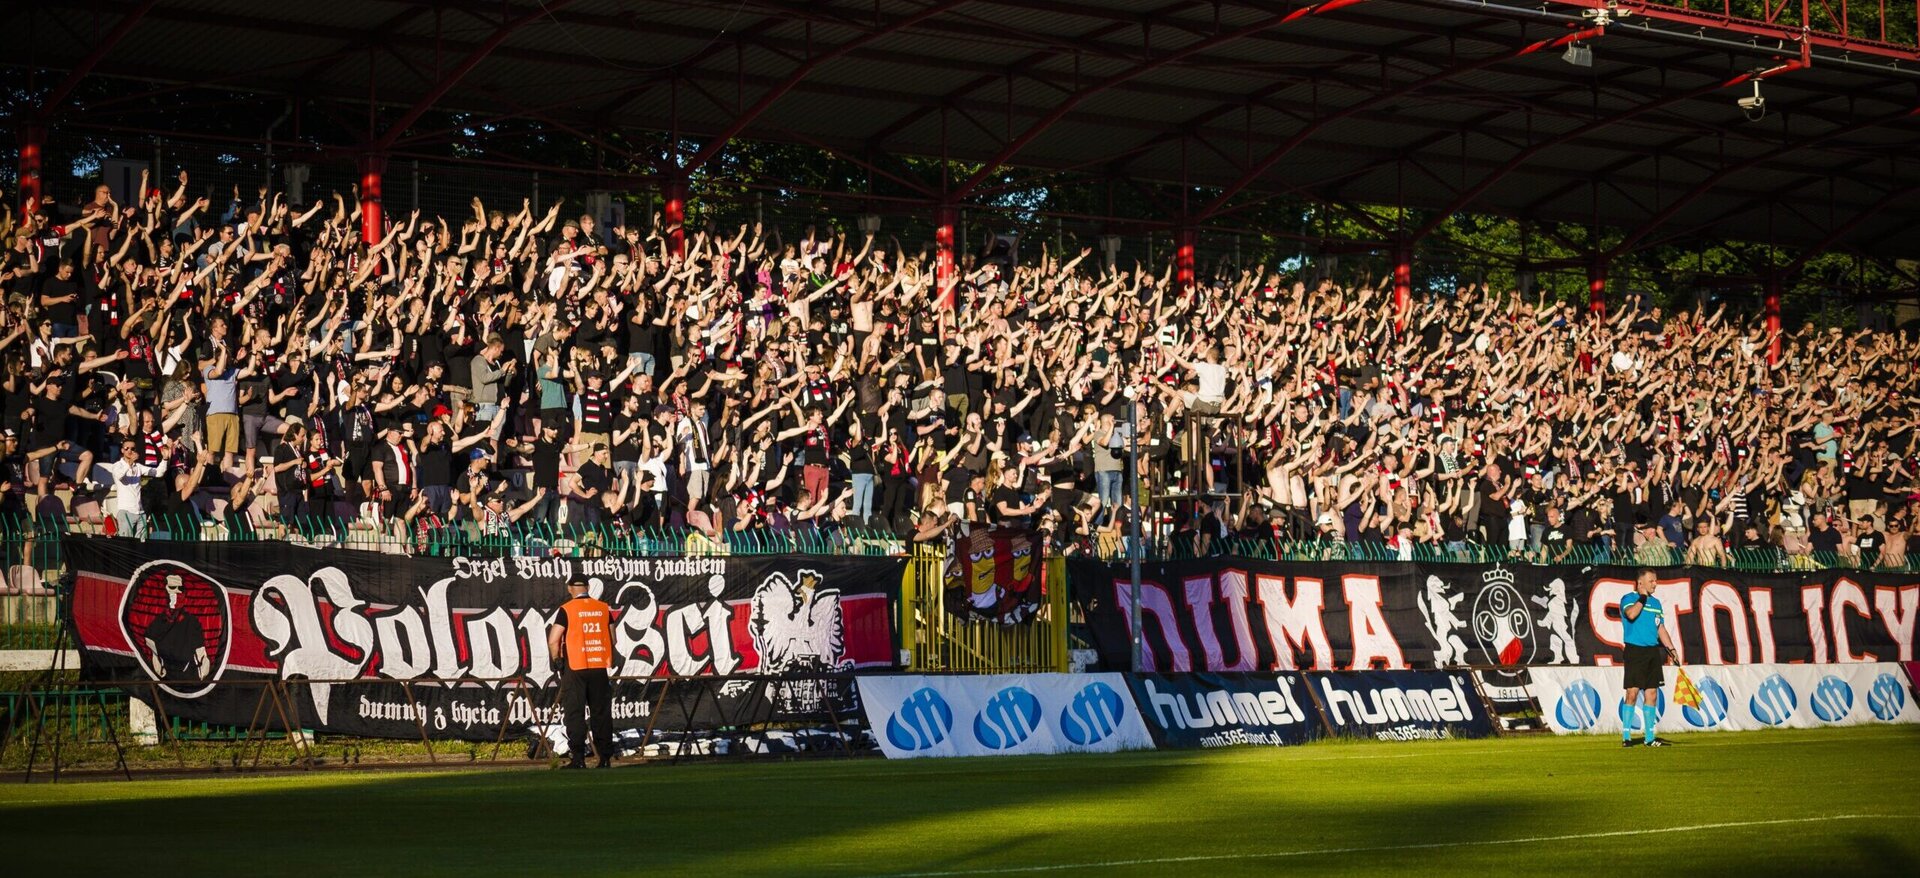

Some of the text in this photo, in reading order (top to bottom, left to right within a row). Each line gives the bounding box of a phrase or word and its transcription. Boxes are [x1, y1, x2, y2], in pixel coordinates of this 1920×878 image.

[581, 556, 650, 581] naszym
[655, 556, 726, 581] znakiem
[1494, 590, 1505, 610] S
[583, 622, 601, 633] 021
[1113, 567, 1411, 672] DUMA
[1480, 614, 1523, 636] K P
[359, 695, 428, 727] dumny
[434, 705, 446, 730] z
[452, 700, 500, 730] bycia
[1145, 676, 1305, 729] hummel
[1321, 675, 1473, 726] hummel
